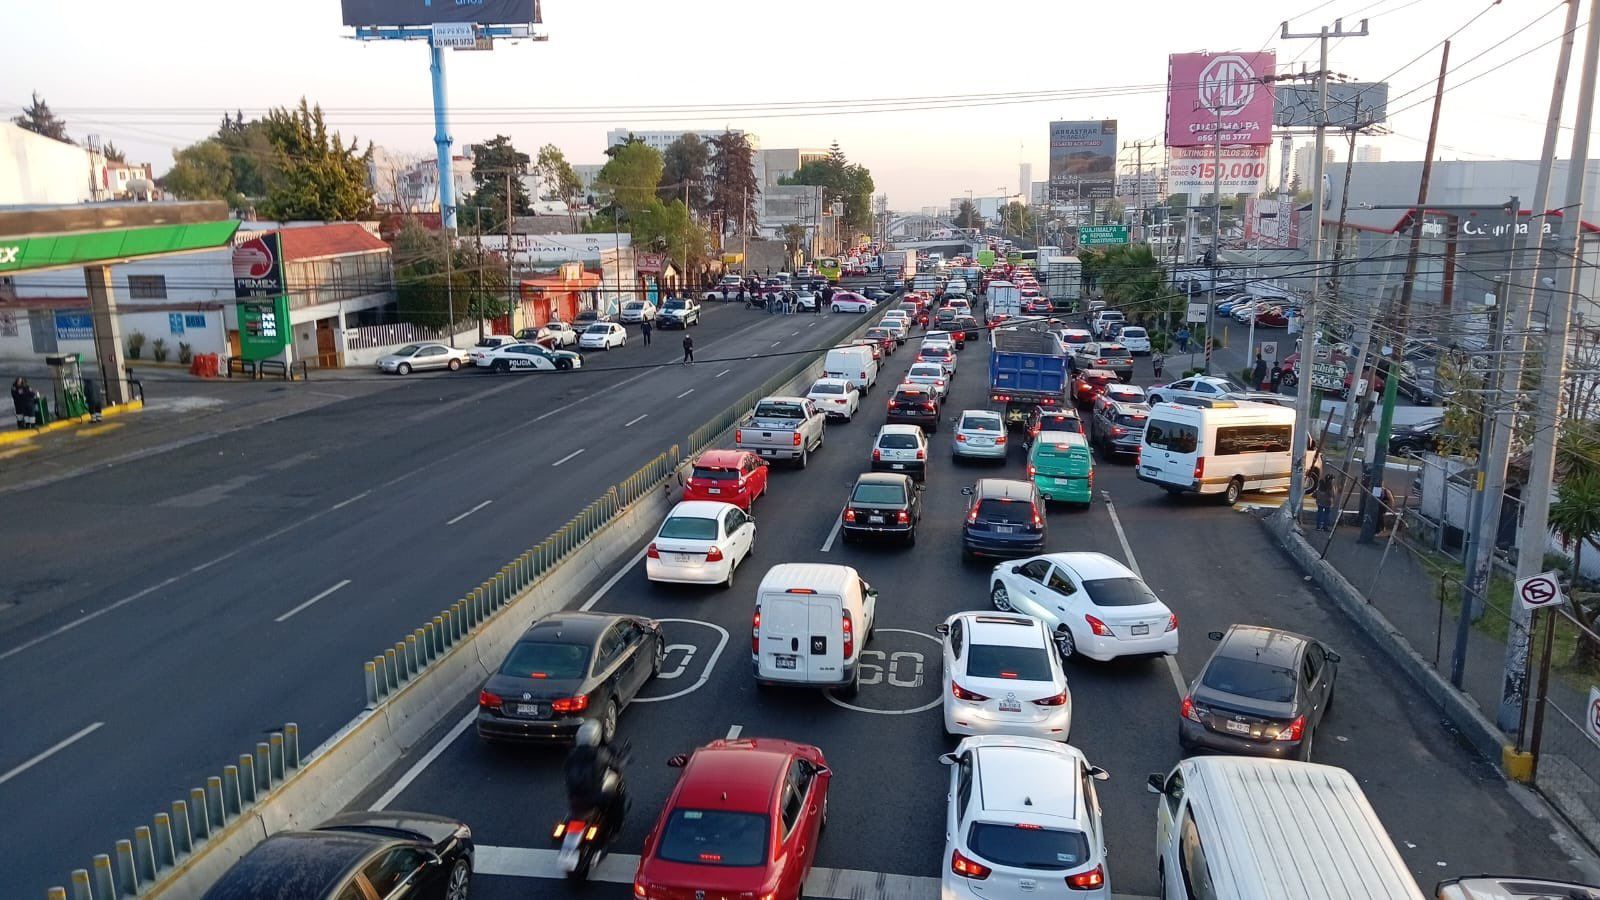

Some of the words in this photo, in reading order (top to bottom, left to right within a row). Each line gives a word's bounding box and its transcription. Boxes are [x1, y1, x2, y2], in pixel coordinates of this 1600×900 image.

[1205, 62, 1249, 107] MG
[1208, 149, 1241, 157] MDELOS
[237, 279, 278, 289] PEMEX
